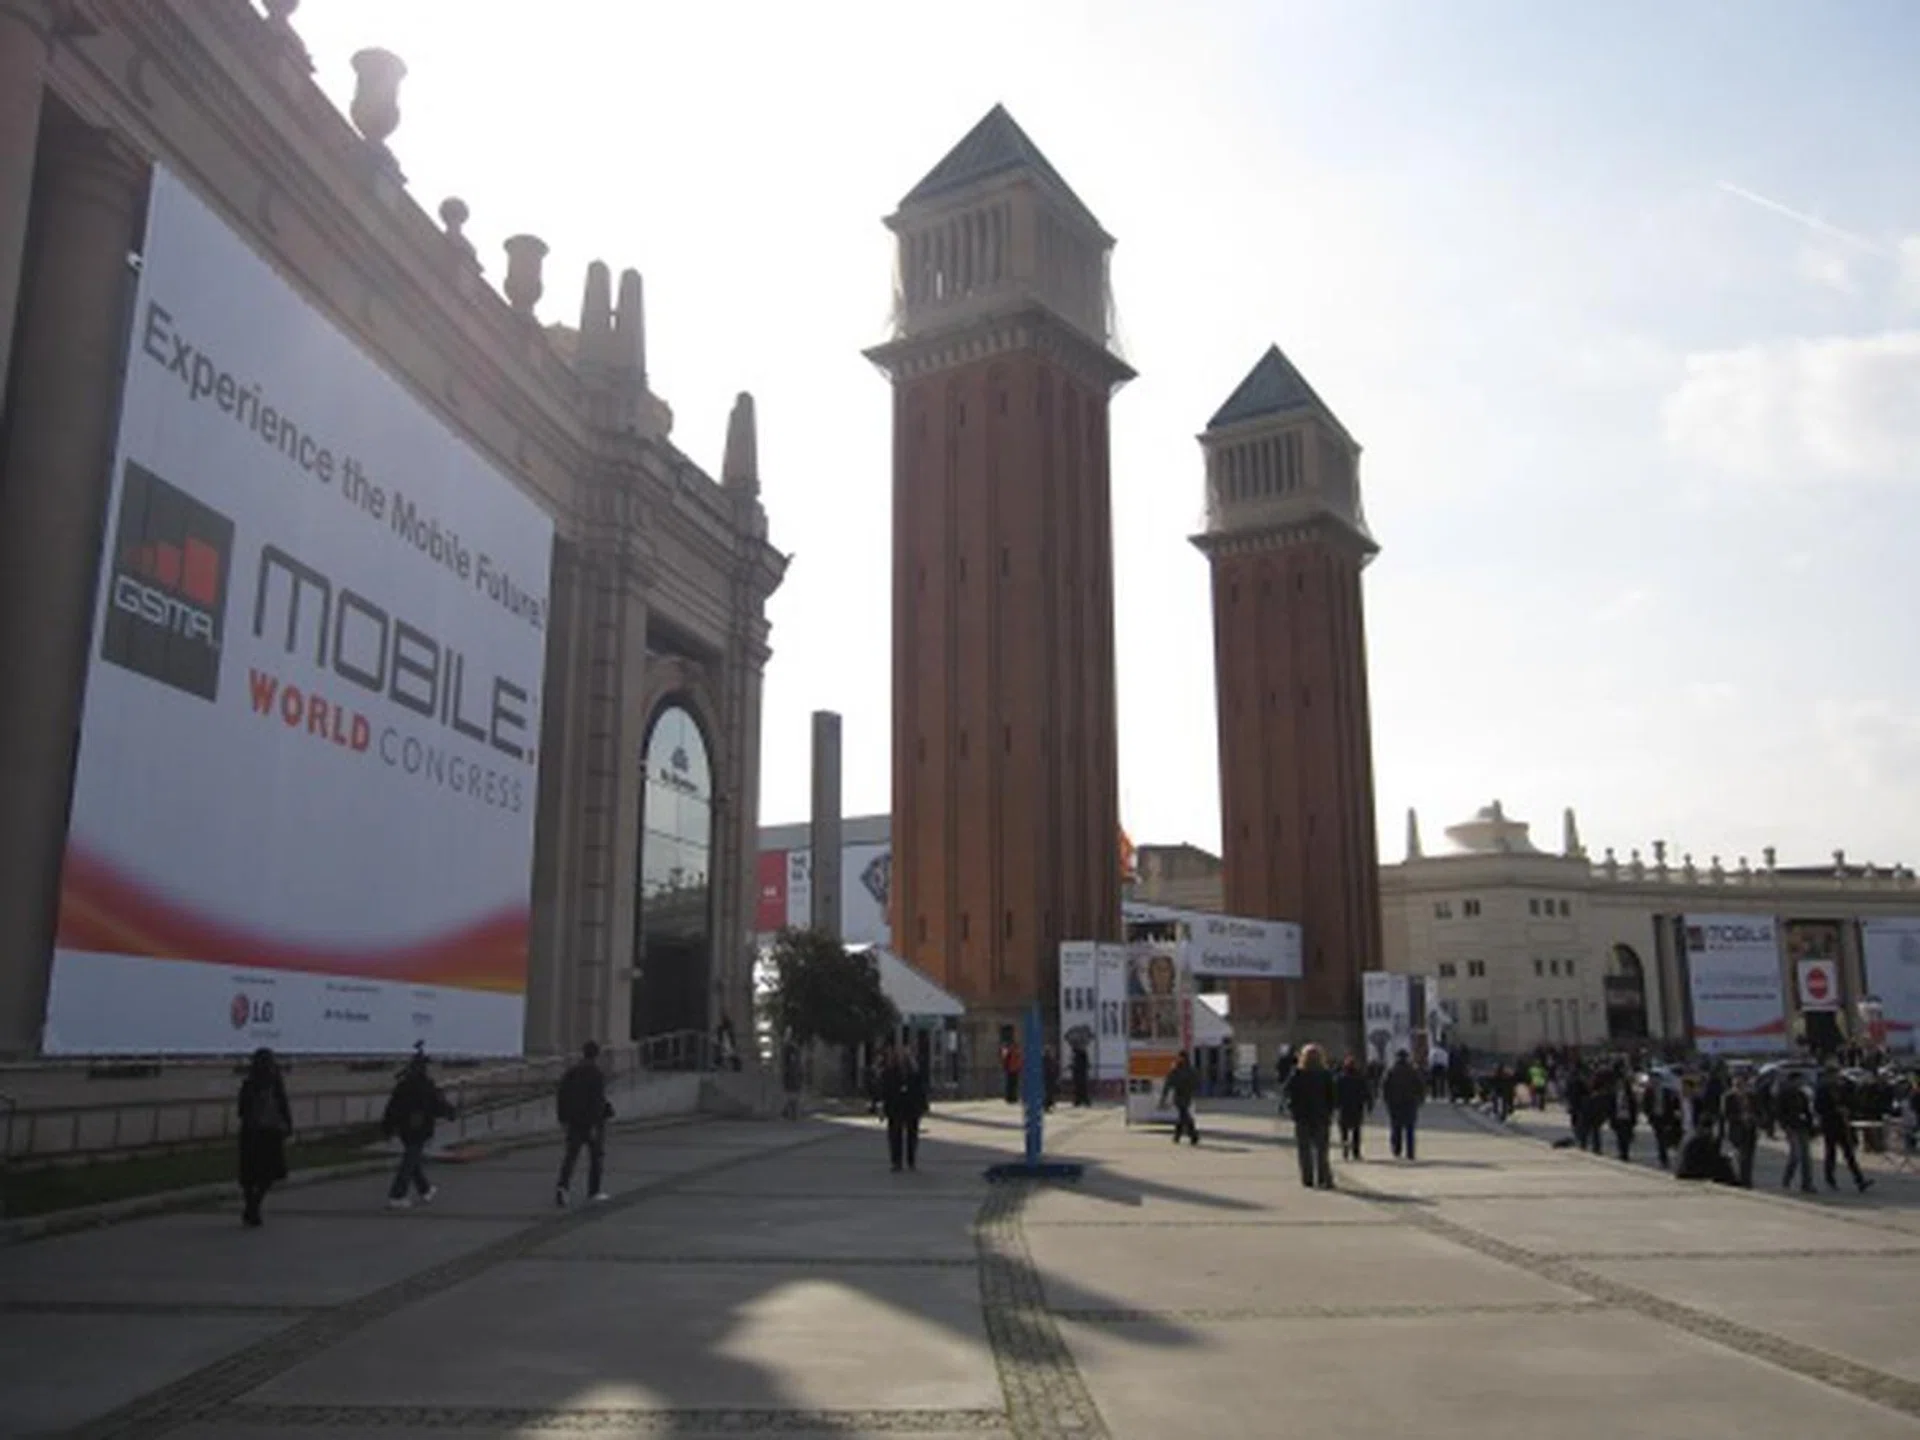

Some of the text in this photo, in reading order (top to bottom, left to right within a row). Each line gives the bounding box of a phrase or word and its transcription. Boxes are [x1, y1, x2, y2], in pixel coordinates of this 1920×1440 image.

[143, 301, 335, 484] Experience
[342, 457, 386, 520] the
[391, 491, 470, 580] Mobile
[114, 574, 214, 647] GSMA
[248, 667, 523, 813] WORLD CONGRESS
[252, 1000, 275, 1023] LG
